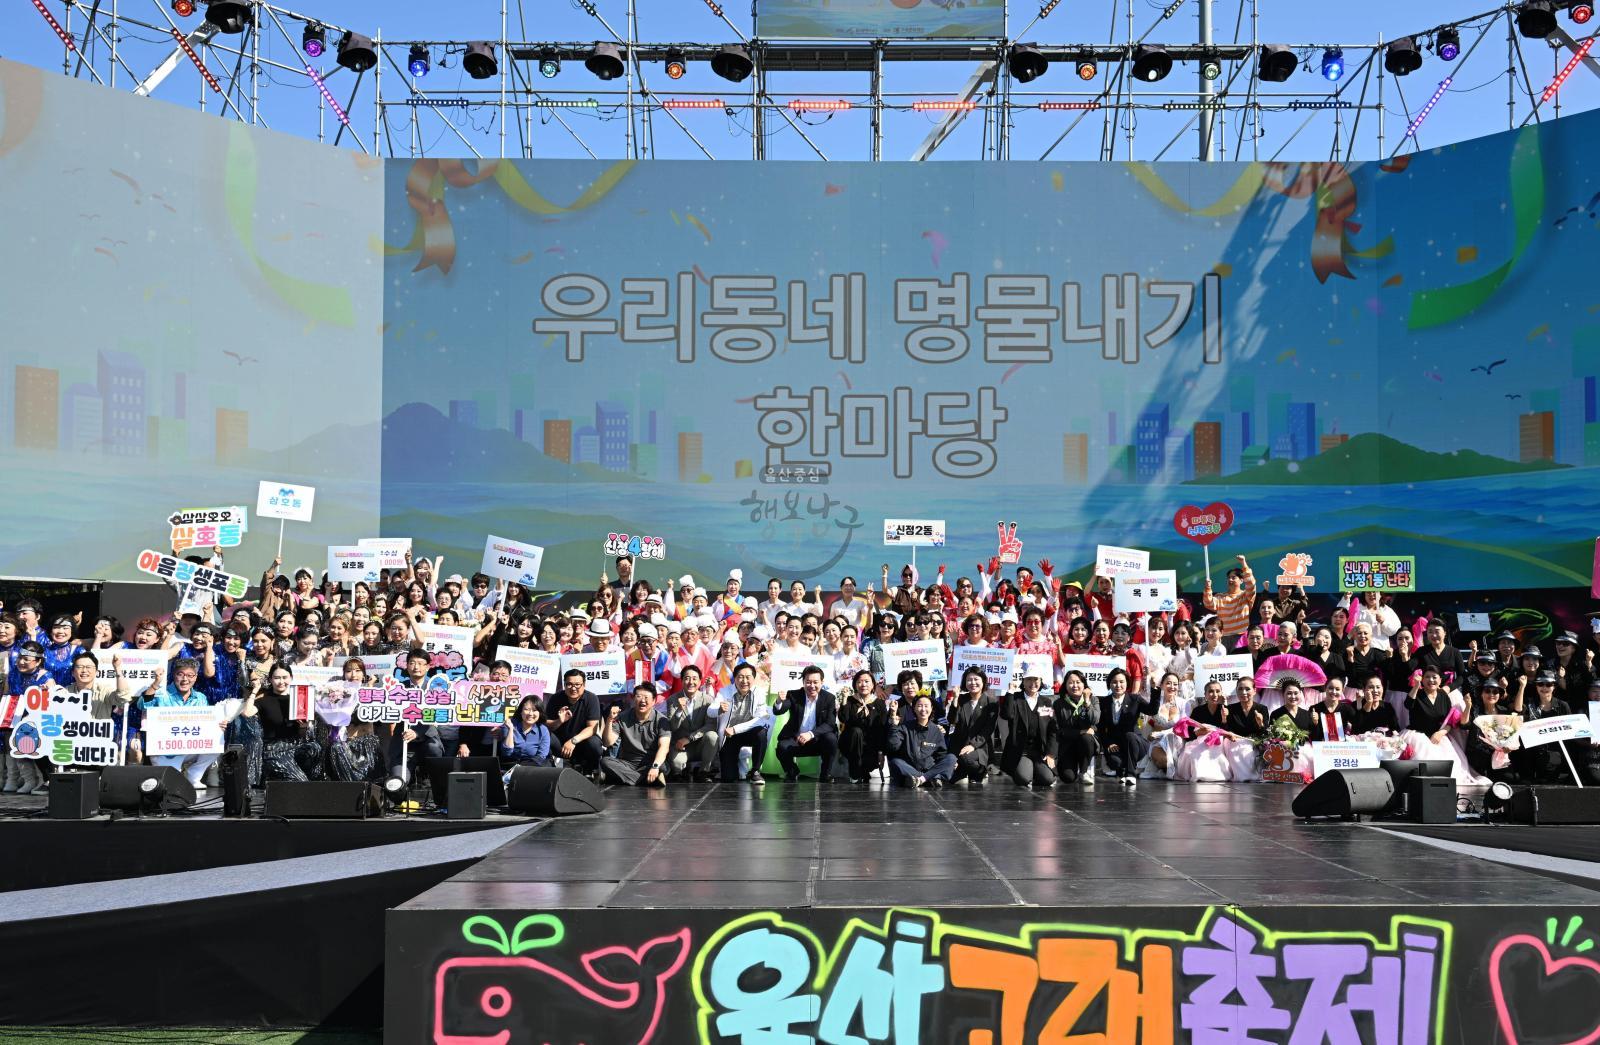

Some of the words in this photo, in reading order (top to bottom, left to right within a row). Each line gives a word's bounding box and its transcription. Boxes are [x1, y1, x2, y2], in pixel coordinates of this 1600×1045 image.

[533, 271, 868, 363] 우리동네
[894, 272, 1222, 364] 명물내기
[753, 386, 1009, 478] 한마당
[764, 466, 822, 483] 울산중심
[896, 525, 933, 536] 신정2동
[341, 561, 365, 569] 삼호동
[498, 555, 523, 569] 삼산동
[1104, 557, 1122, 566] 빛나는
[1123, 561, 1141, 570] 스타상
[1343, 561, 1371, 574] 신나게
[1344, 574, 1385, 588] 신정1동
[1386, 574, 1410, 588] 난타
[513, 664, 539, 675] 장려상
[901, 658, 928, 669] 대현동
[1209, 672, 1240, 682] 신정3동
[358, 689, 386, 703] 행복
[387, 686, 421, 704] 수직
[424, 689, 455, 704] 상승!
[359, 706, 400, 720] 여기는
[402, 703, 453, 723] 수암동!
[40, 714, 110, 738] 장생이네
[170, 726, 201, 736] 우수상
[1333, 758, 1359, 768] 장려상
